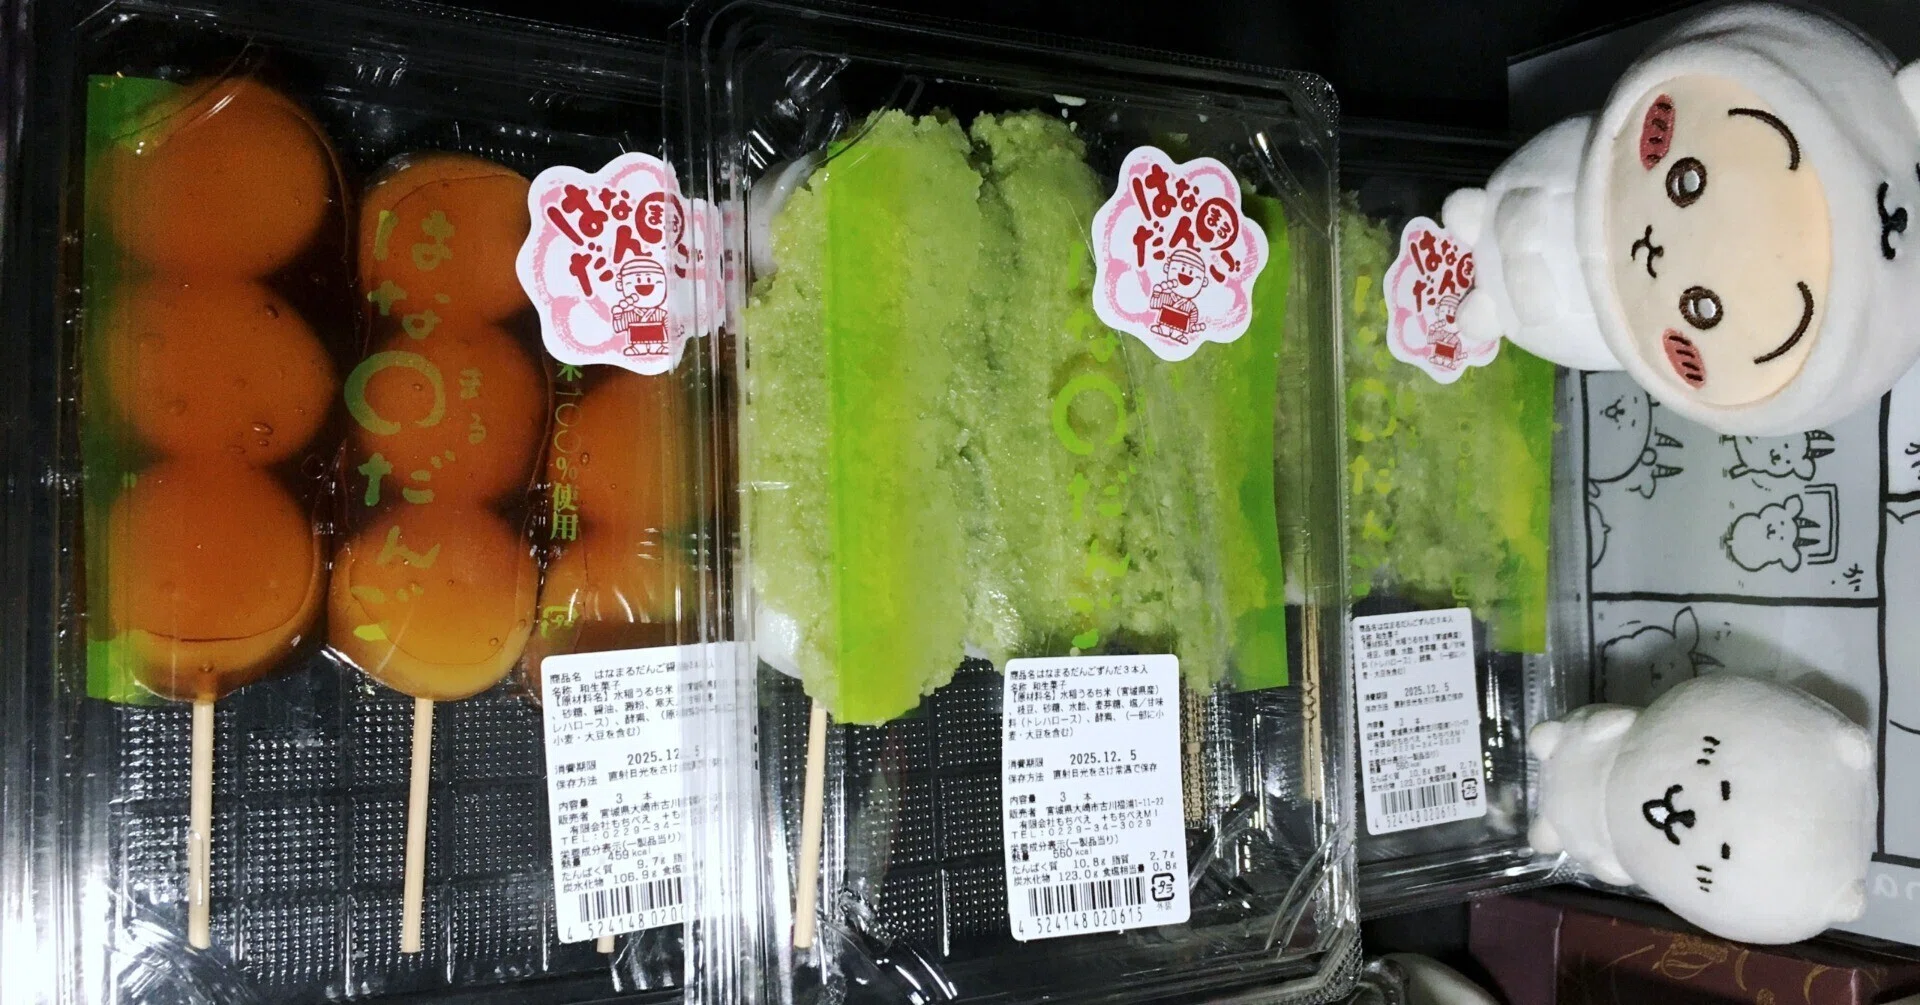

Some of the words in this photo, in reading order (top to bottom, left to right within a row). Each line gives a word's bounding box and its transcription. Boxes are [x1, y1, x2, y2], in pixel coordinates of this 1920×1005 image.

[1133, 164, 1199, 221] はな
[1207, 207, 1231, 239] まる
[547, 184, 632, 246] はな
[1133, 216, 1240, 282] だんご
[1411, 230, 1458, 275] はな
[550, 672, 581, 683] 商品名
[552, 686, 572, 697] 名称
[580, 681, 620, 693] 和生菓子
[1033, 680, 1067, 690] 和生菓子
[1131, 749, 1137, 760] 5
[556, 776, 598, 790] 保存方法
[1008, 772, 1044, 783] 保存方法
[616, 793, 623, 804] 3
[643, 791, 652, 800] 本
[1060, 792, 1066, 802] 3
[1084, 792, 1092, 801] 本
[558, 812, 589, 825] 販売者
[1009, 808, 1036, 819] 販売者
[570, 815, 651, 835] 有限会社もちべえ
[1020, 814, 1091, 830] 有限会社もちべえ
[1012, 861, 1058, 874] たんぱく質
[1112, 854, 1129, 865] 脂質
[562, 864, 612, 881] たんぱく質
[563, 878, 604, 893] 炭水化物
[1014, 874, 1051, 887] 炭水化物
